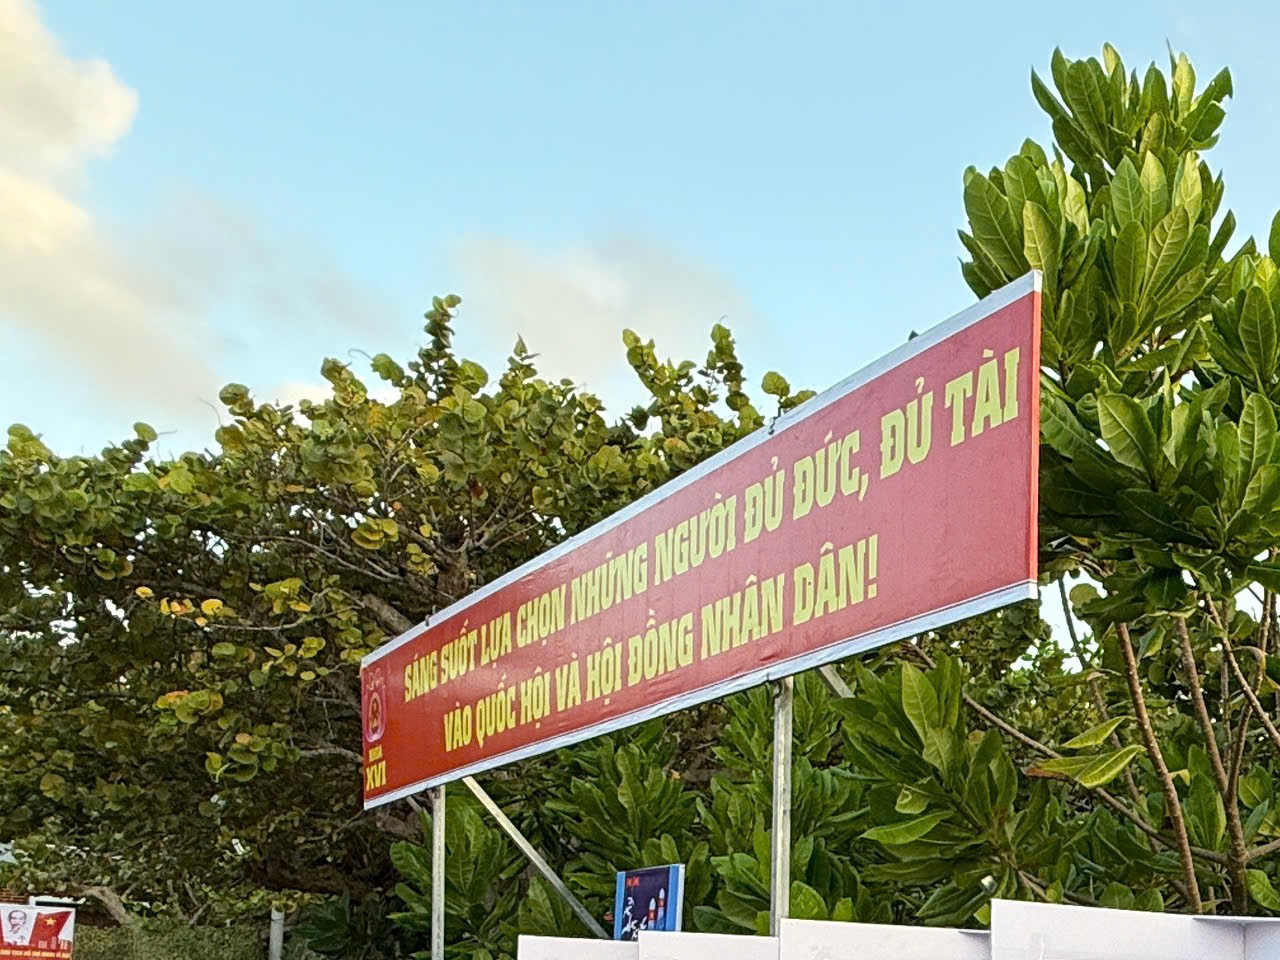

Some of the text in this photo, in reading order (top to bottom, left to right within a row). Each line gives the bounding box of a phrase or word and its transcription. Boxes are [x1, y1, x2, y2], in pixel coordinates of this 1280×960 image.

[404, 346, 1020, 703] SÁNG SUỐT LỰA CHỌN NHỮNG NGƯỜI ĐỦ ĐỨC, ĐỦ TÀI
[443, 533, 879, 753] VÀO QUỐC HỘI VÀ HỘI ĐỒNG NHÂN DÂN!
[365, 760, 386, 791] XVI
